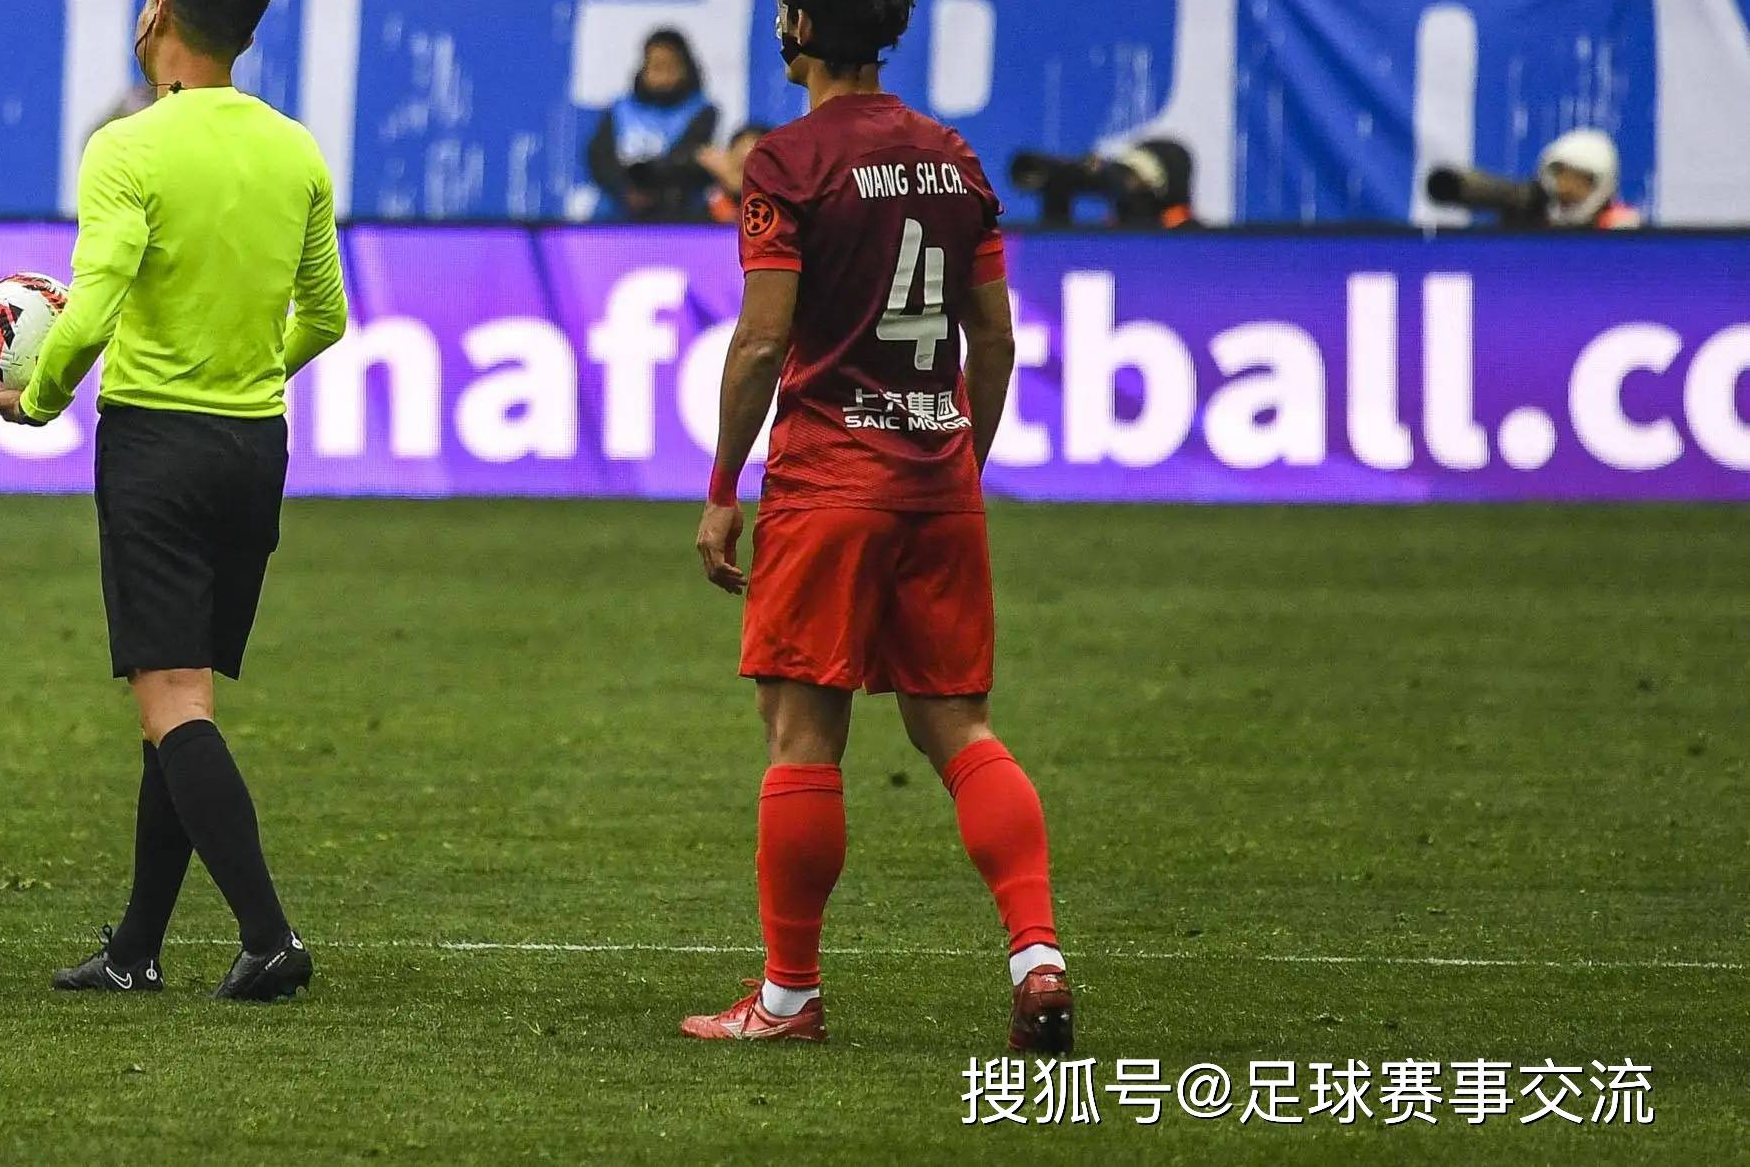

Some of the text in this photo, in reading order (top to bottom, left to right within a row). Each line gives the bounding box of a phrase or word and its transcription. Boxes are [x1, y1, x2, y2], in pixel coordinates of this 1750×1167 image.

[852, 162, 968, 199] WANG SH.CH.
[876, 217, 948, 371] 4
[844, 415, 972, 432] SAIC MOTOR
